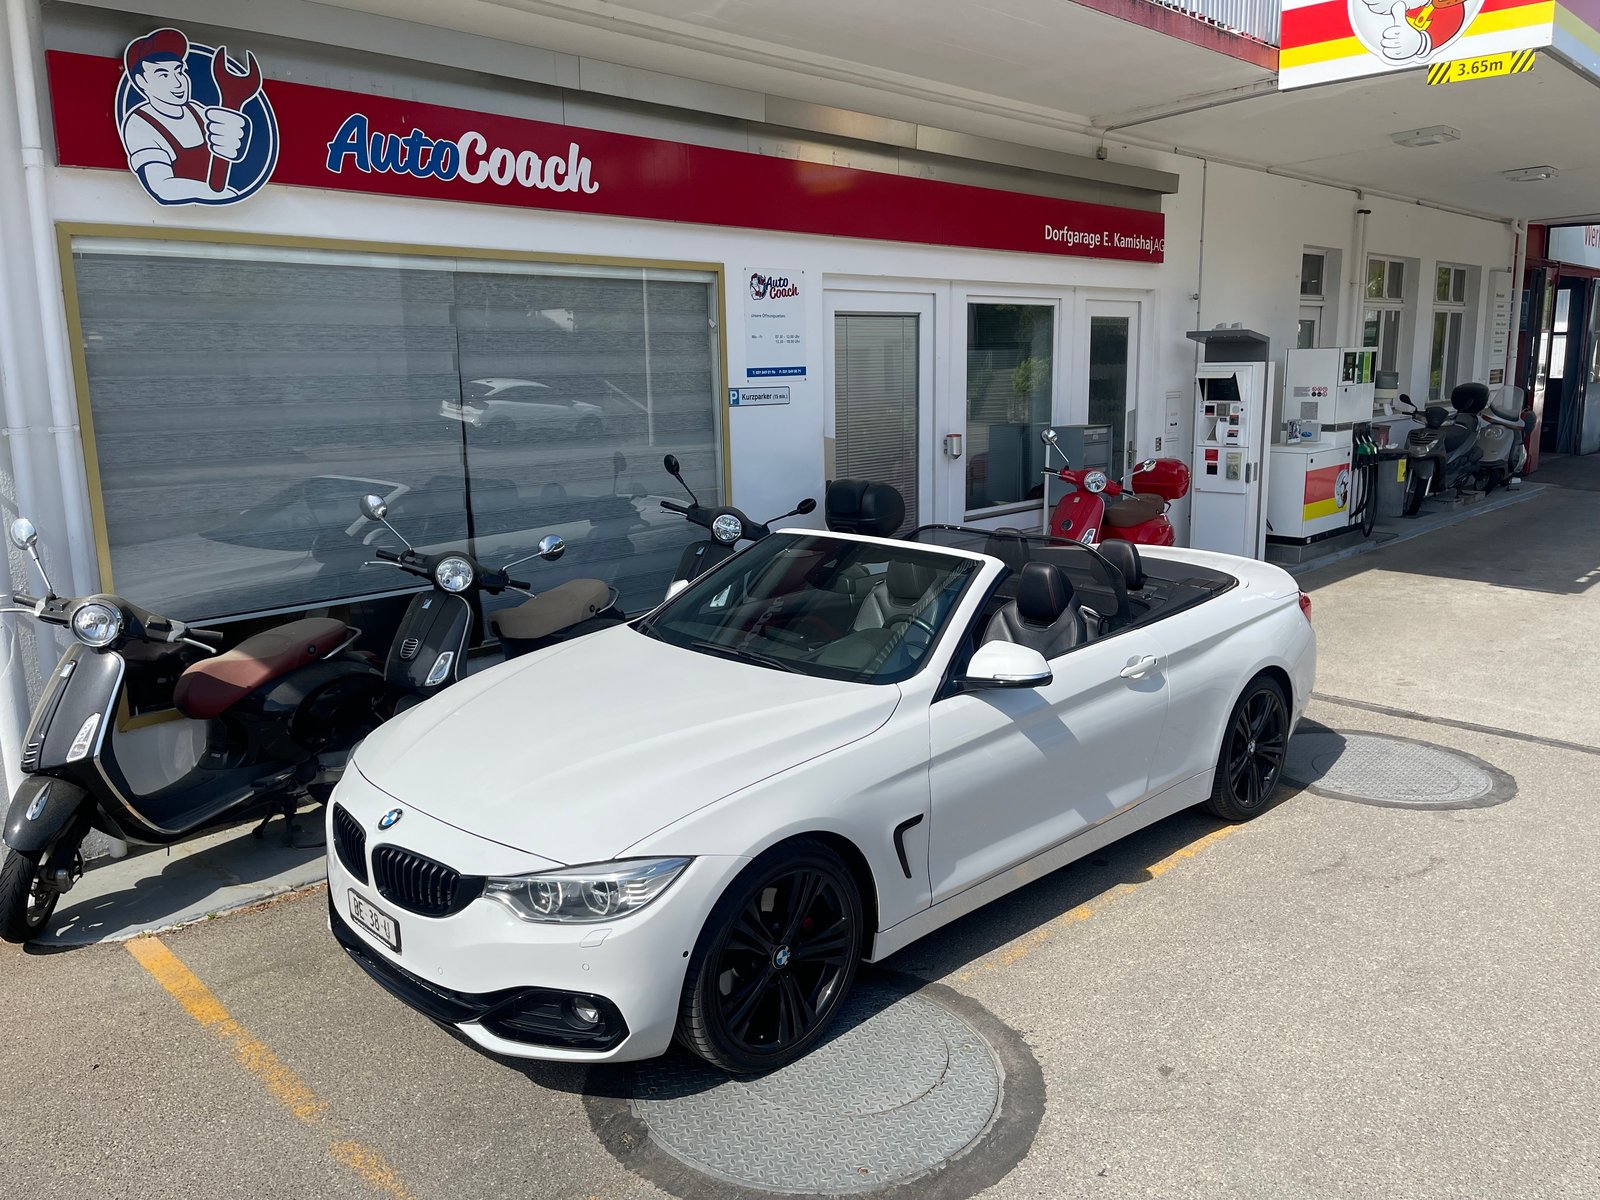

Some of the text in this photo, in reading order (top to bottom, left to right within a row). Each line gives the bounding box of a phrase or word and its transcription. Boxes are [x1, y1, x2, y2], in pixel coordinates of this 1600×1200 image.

[1458, 60, 1503, 76] 3.65m
[1044, 225, 1101, 249] Dorfgarage
[1103, 231, 1112, 247] E.
[765, 276, 789, 291] Auto
[769, 283, 800, 300] Coach
[741, 393, 772, 401] Kurzparker
